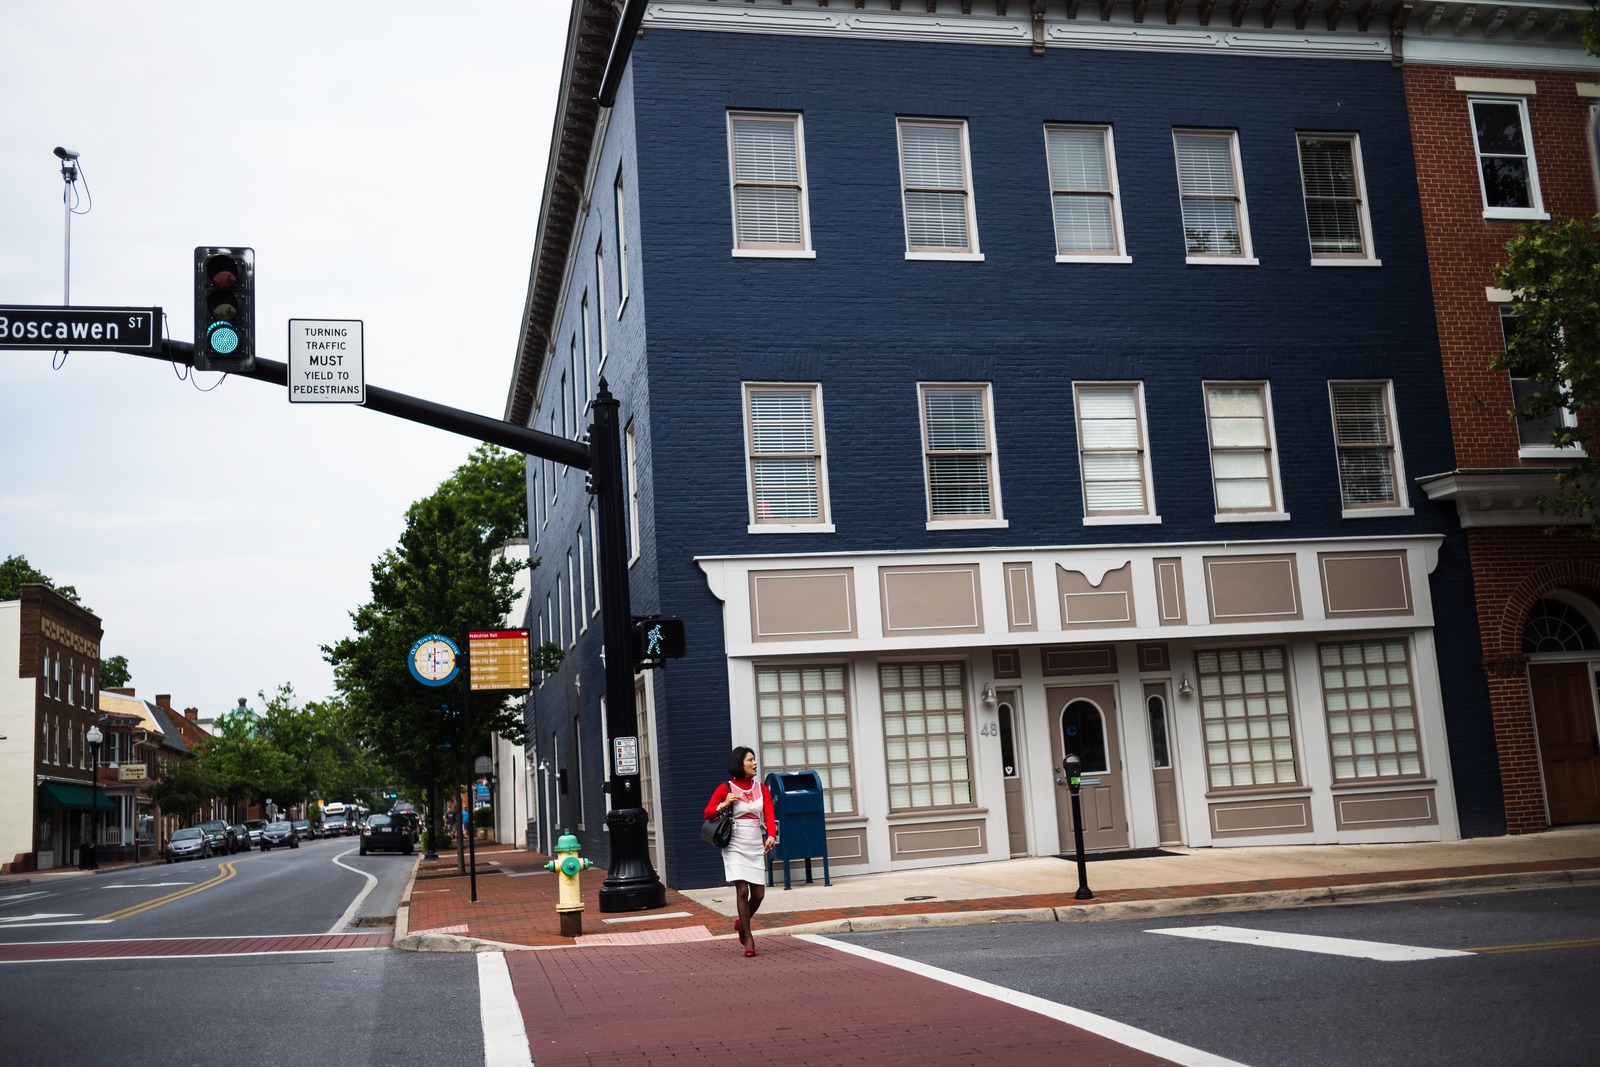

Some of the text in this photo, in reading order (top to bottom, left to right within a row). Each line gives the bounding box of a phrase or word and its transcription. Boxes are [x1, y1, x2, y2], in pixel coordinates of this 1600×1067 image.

[0, 316, 143, 339] Boscawen ST
[305, 328, 347, 337] TURNING
[306, 341, 346, 350] TRAFFIC
[309, 355, 343, 366] MUST
[304, 371, 349, 380] YIELD TO
[293, 385, 359, 394] PEDESTRIANS
[980, 722, 998, 737] 48
